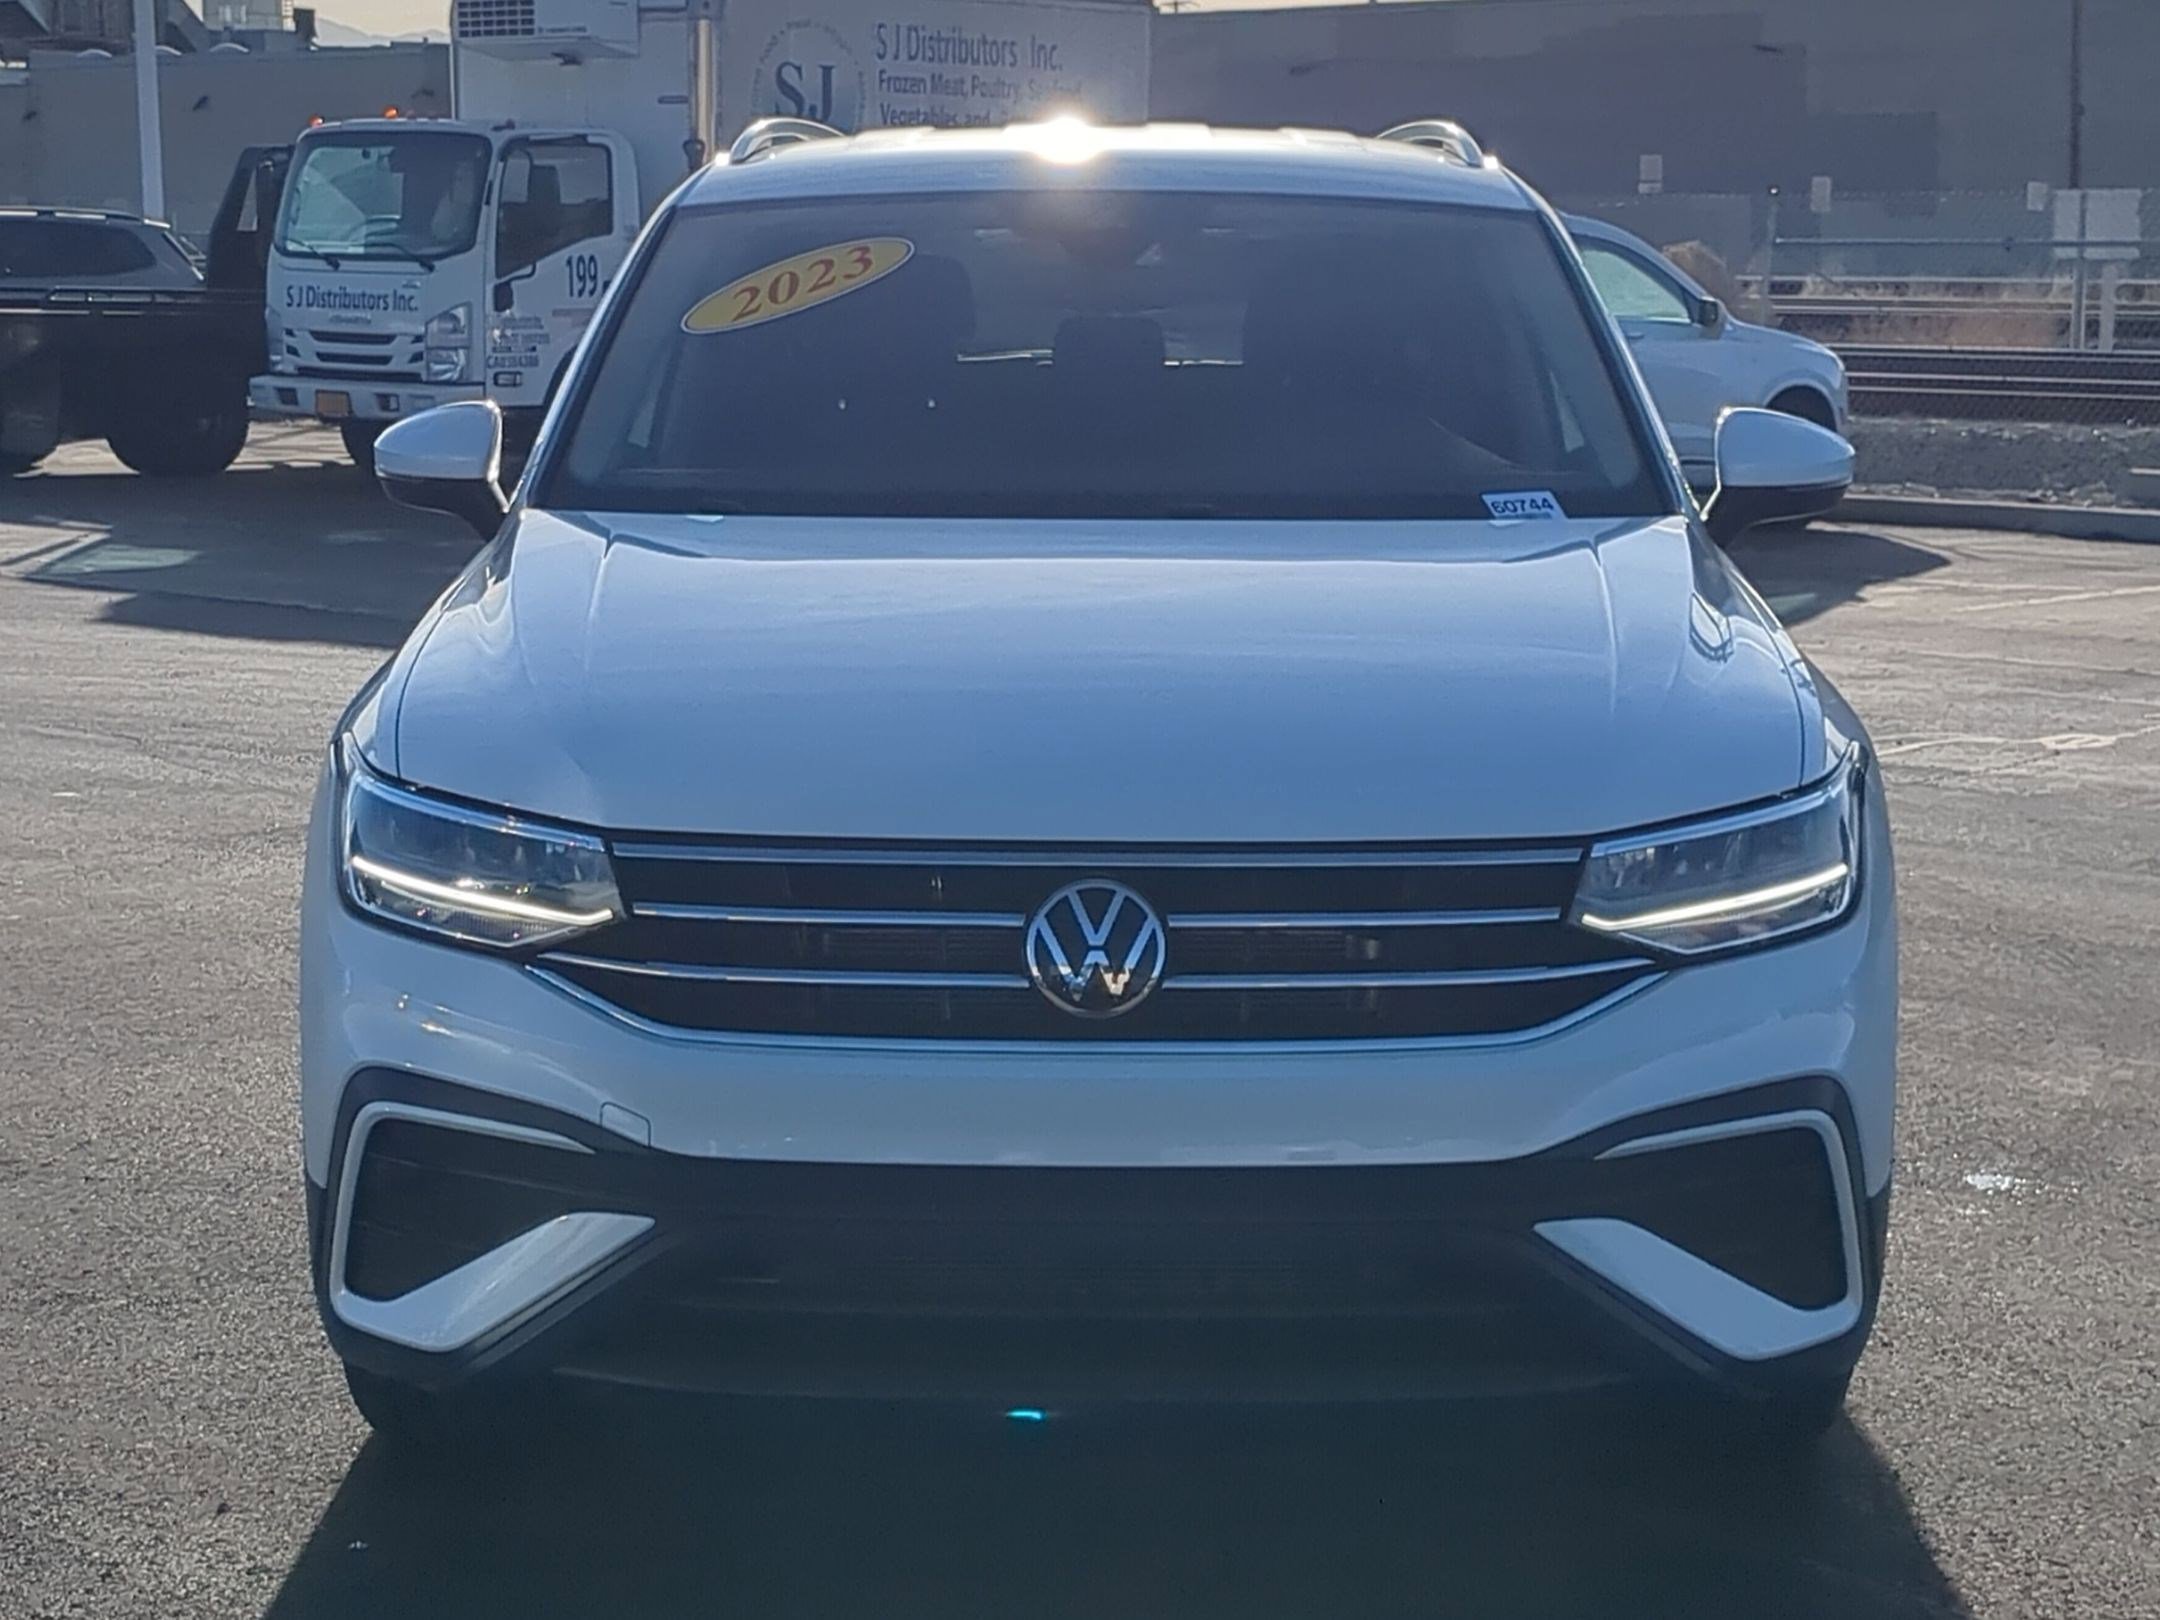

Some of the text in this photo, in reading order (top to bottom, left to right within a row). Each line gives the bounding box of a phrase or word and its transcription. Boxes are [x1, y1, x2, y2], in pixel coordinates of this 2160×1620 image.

[876, 22, 888, 61] S
[893, 24, 901, 61] J
[907, 24, 1018, 69] Distributors
[1030, 34, 1063, 72] Inc.
[878, 68, 927, 95] Frozen
[931, 72, 967, 99] Meat,
[565, 253, 599, 299] 199
[732, 246, 874, 321] 2023
[286, 285, 418, 311] S J Distributors Inc.
[1491, 498, 1554, 514] 60744
